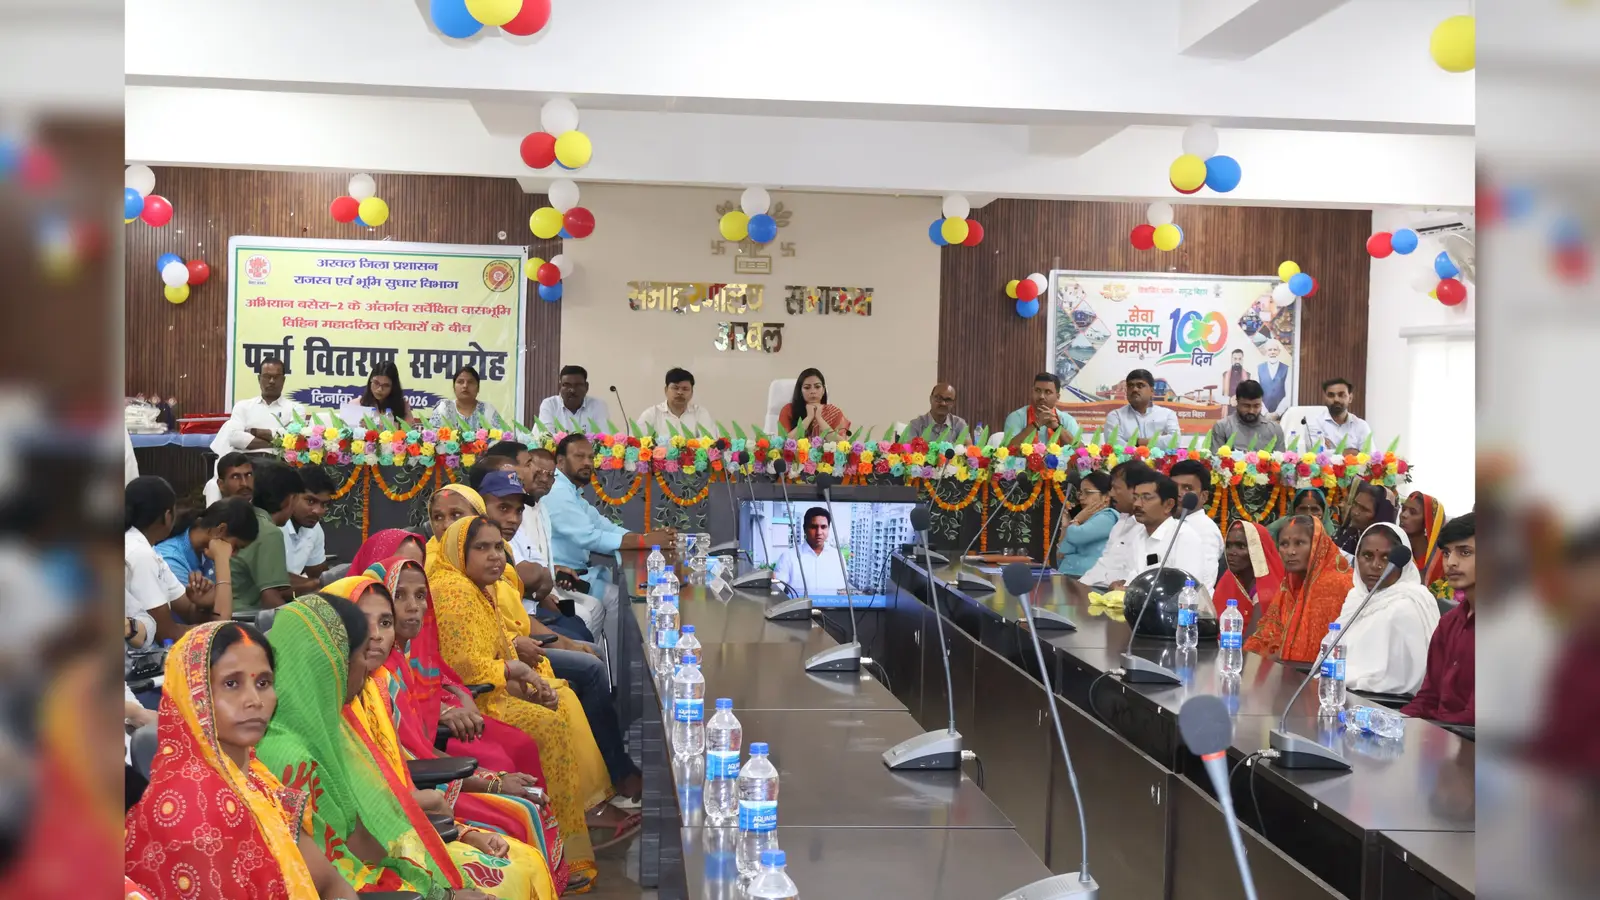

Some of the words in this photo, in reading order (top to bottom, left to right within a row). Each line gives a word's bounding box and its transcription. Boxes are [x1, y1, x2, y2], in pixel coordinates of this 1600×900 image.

[317, 258, 356, 269] अरवल
[359, 257, 389, 270] जिला
[393, 261, 439, 272] प्रशासन
[294, 275, 332, 285] राजस्व
[335, 274, 355, 286] एवं
[356, 275, 381, 289] भूमि
[385, 278, 417, 290] सुधार
[420, 277, 459, 290] विभाग
[245, 296, 294, 309] अभियान
[347, 300, 362, 311] के
[365, 300, 409, 313] अंतर्गत
[461, 304, 511, 318] वासभूमि
[1128, 305, 1154, 323] सेवा
[282, 316, 318, 329] विहिन
[321, 318, 380, 331] महादलित
[383, 320, 429, 332] परिवारों
[431, 321, 444, 332] के
[448, 322, 472, 333] बीच
[1116, 320, 1160, 337] संकल्प
[1169, 307, 1229, 353] 100
[714, 321, 785, 353] अरवल
[1117, 336, 1163, 354] समर्पण
[303, 336, 399, 377] वितरण
[407, 341, 508, 382] समारोह
[1191, 347, 1214, 366] दिन
[311, 389, 354, 405] दिनांक
